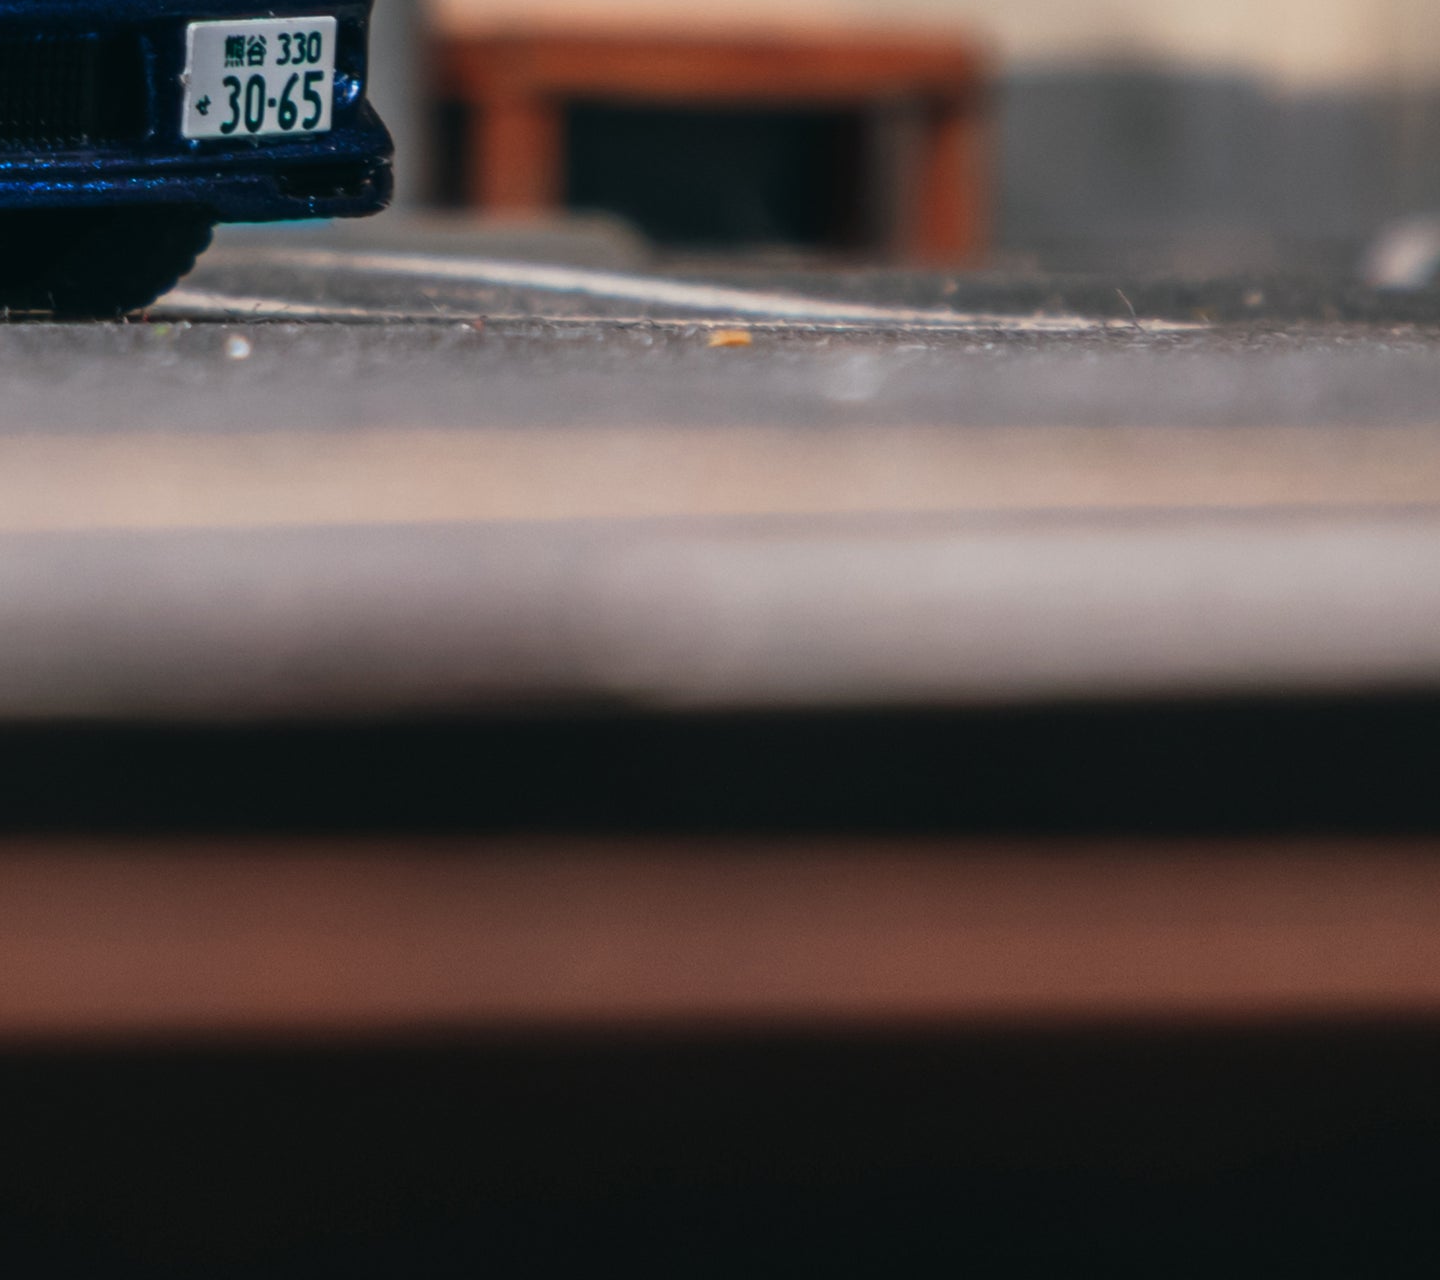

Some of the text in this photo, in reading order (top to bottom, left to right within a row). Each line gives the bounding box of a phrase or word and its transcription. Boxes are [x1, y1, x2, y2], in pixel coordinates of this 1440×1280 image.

[224, 30, 322, 68] 熊谷 330
[220, 69, 325, 135] 30-65
